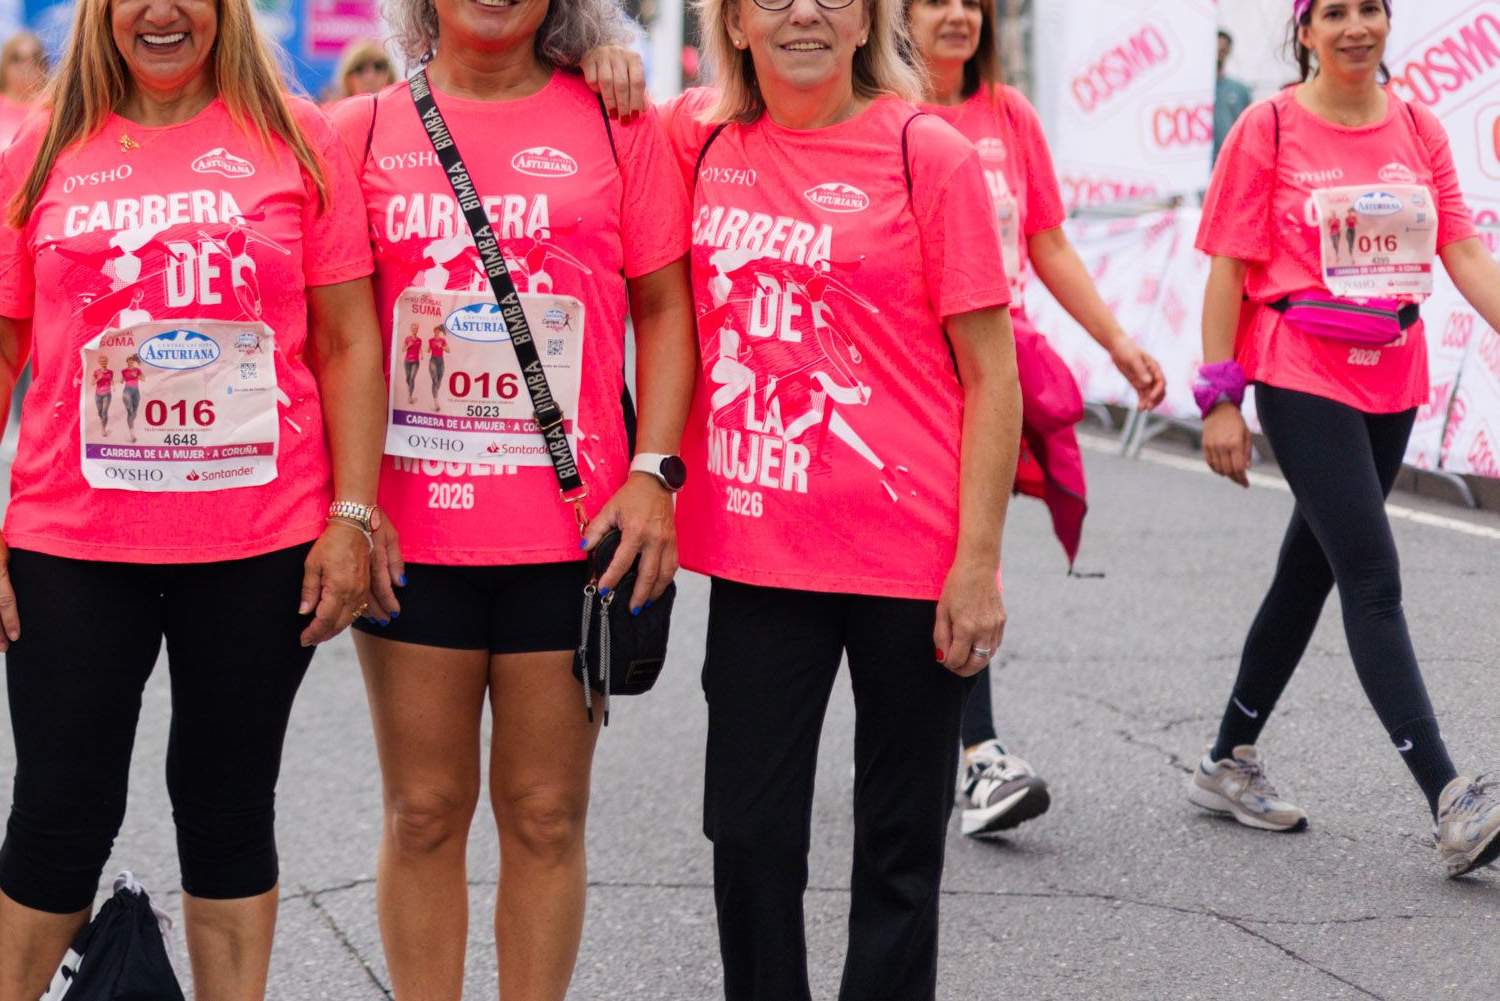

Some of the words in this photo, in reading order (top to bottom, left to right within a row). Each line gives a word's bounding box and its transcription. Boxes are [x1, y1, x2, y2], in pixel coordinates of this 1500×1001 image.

[1071, 26, 1169, 112] COSMO
[422, 105, 453, 151] BIMBA
[516, 155, 573, 173] ASTURIANA
[63, 164, 132, 193] OYSHO
[448, 161, 481, 211] BIMBA
[65, 189, 246, 238] CARRERA
[387, 193, 550, 243] CARERA
[475, 225, 507, 278] BIMBA
[1358, 235, 1397, 253] 016
[164, 240, 224, 308] DE
[412, 304, 442, 317] SUMA
[500, 292, 532, 346] BIMBA
[748, 272, 803, 343] DE
[145, 345, 214, 360] ASTURIANA
[1347, 348, 1381, 365] 2026
[450, 371, 519, 399] 016
[145, 399, 216, 427] 016
[466, 405, 500, 418] 5023
[745, 372, 784, 436] LA
[406, 415, 445, 428] CARRERA
[446, 419, 458, 429] DE
[460, 420, 472, 430] LA
[474, 420, 505, 431] MUJER
[513, 422, 520, 431] A
[100, 447, 142, 458] CARRERA
[144, 448, 156, 458] DE
[159, 448, 171, 458] LA
[173, 448, 205, 459] MUJER
[212, 448, 219, 457] A
[222, 445, 258, 457] CORUÑA
[163, 434, 198, 446] 4648
[408, 434, 464, 451] OYSHO
[546, 426, 577, 479] BIMBA
[707, 419, 811, 493] MUJER
[105, 466, 164, 482] OYSHO
[202, 467, 254, 481] Santander
[428, 482, 474, 510] 2026
[726, 486, 763, 518] 2026
